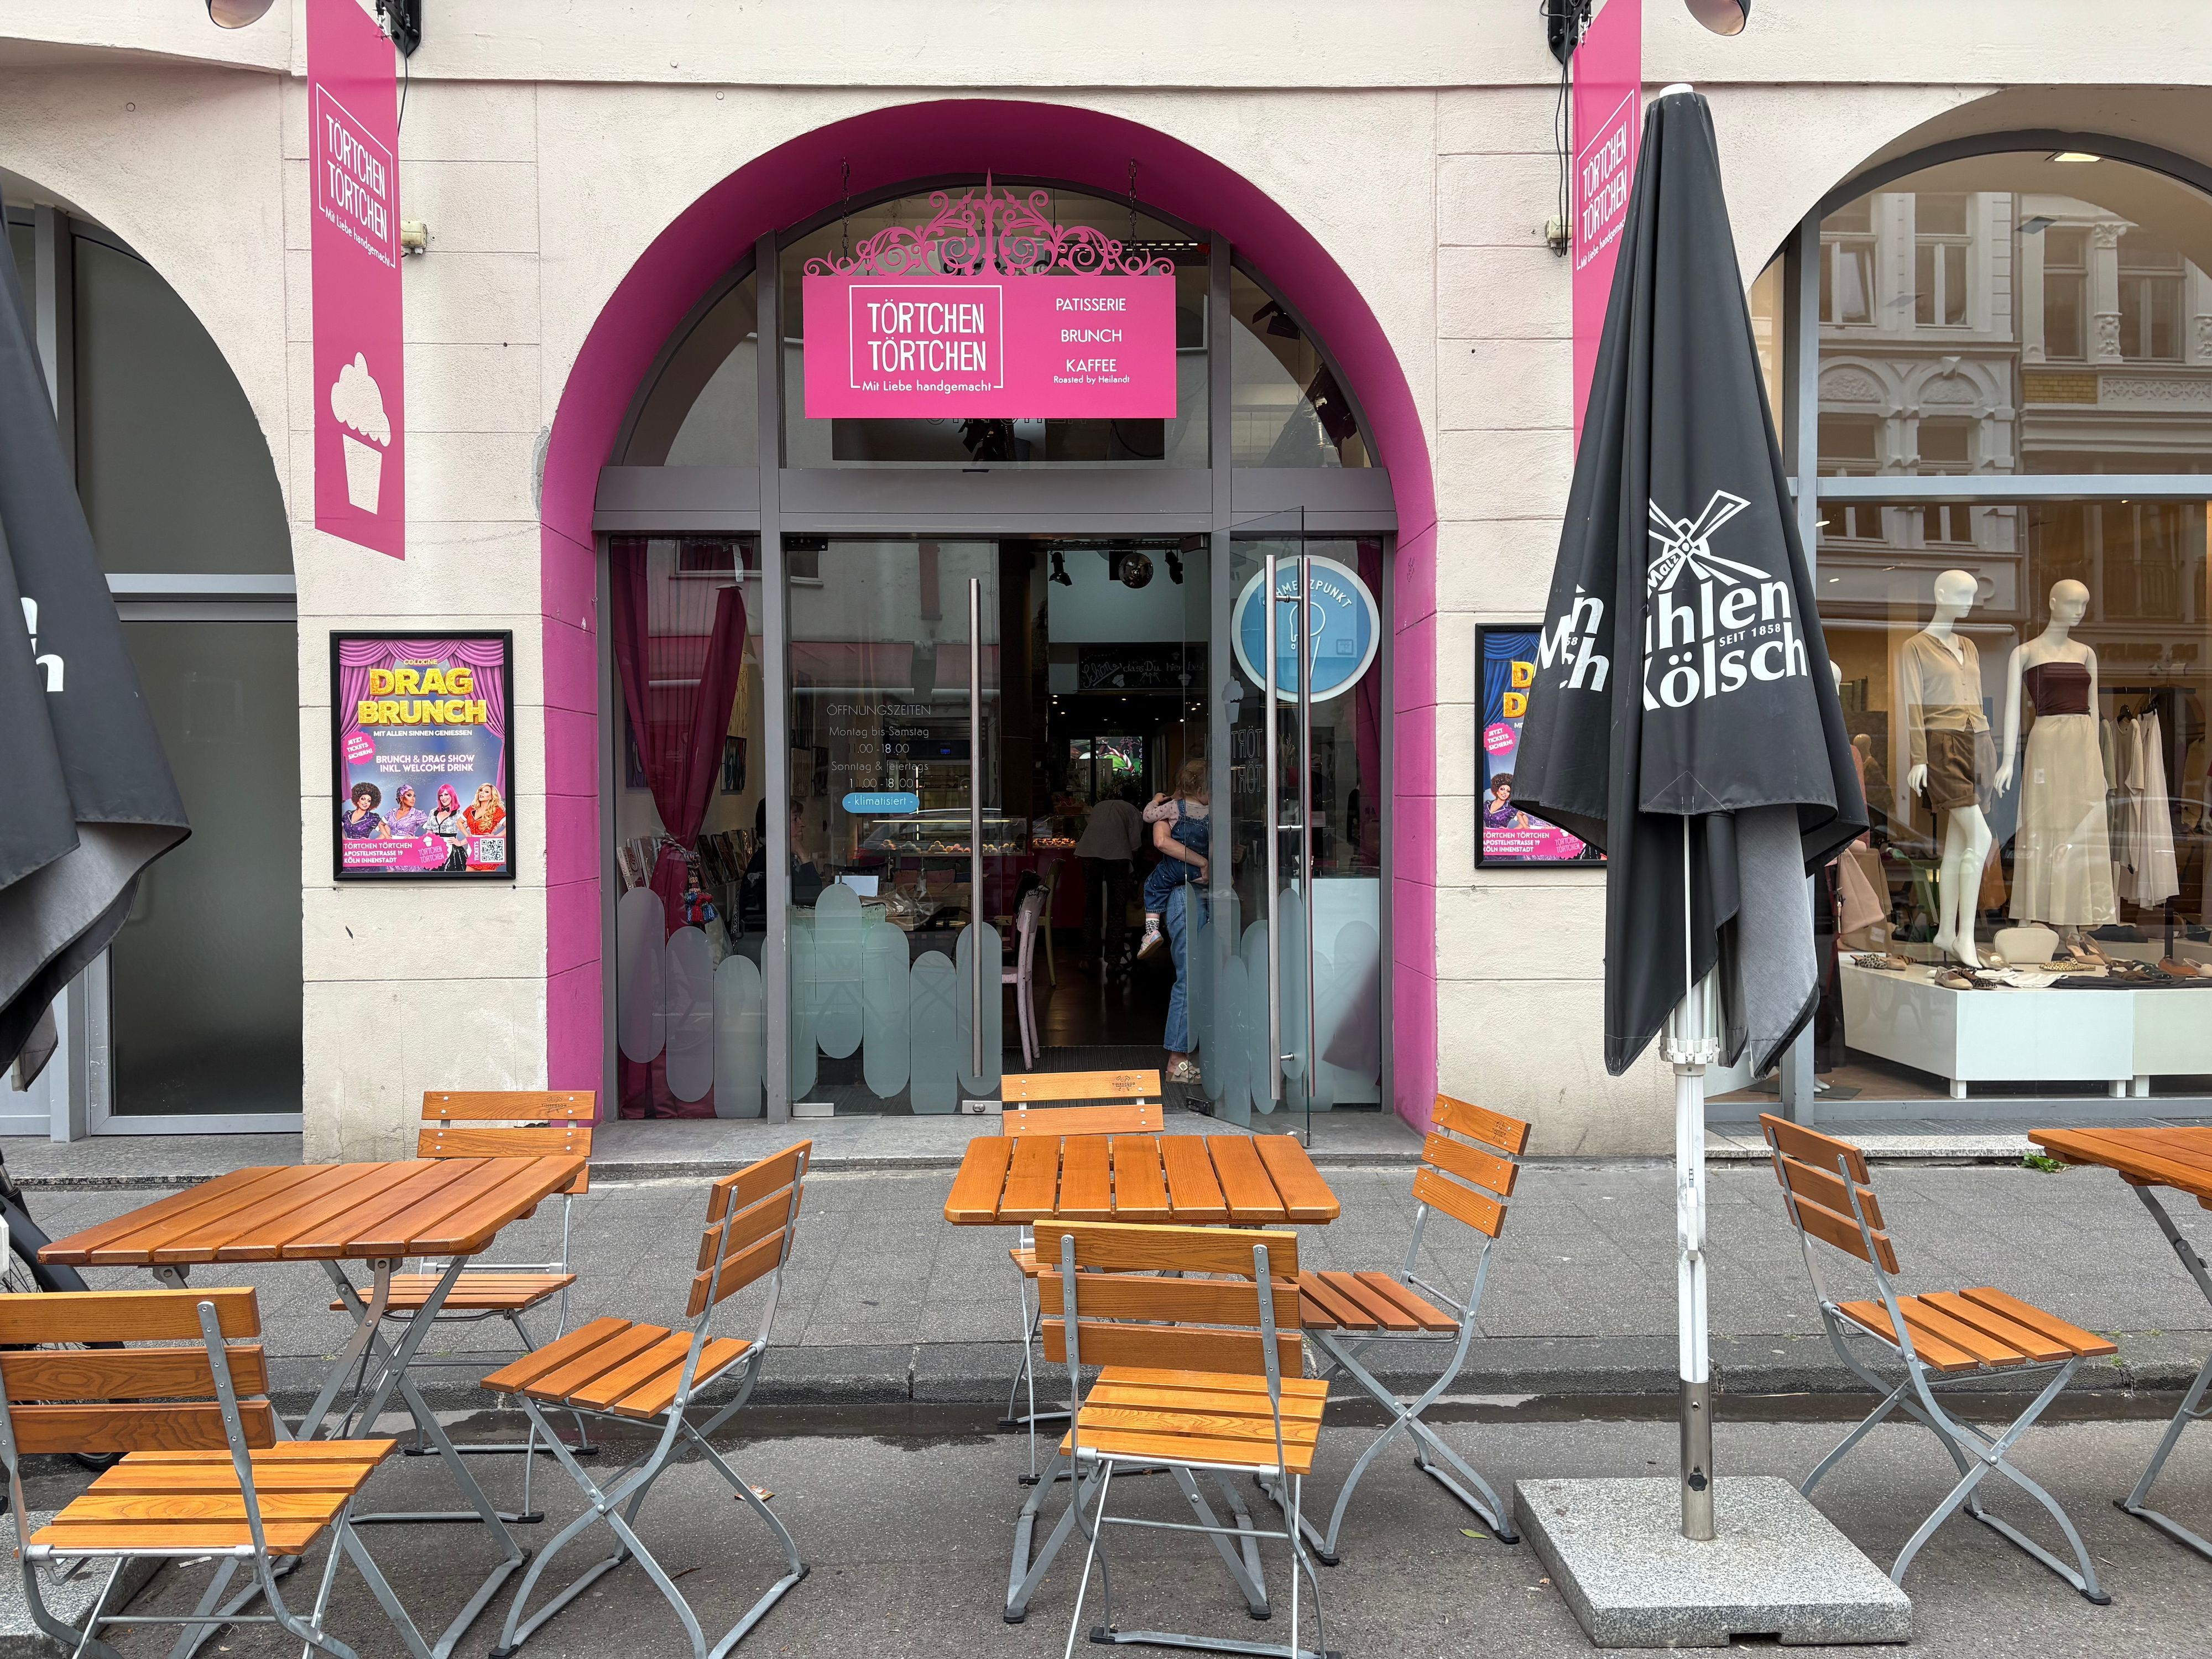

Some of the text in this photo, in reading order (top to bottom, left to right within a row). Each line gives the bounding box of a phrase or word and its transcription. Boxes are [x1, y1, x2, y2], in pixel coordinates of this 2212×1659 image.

[325, 113, 386, 201] TÖRTCHEN
[1582, 121, 1627, 202] TÖRTCHEN
[326, 159, 388, 243] TÖRTCHEN
[1582, 164, 1627, 244] TÖRTCHEN
[325, 206, 390, 267] Mit Liebe handgemacht
[1588, 244, 1599, 263] Liebe
[1056, 298, 1126, 311] PATISSERIE
[867, 298, 984, 335] TÖRTCHEN
[1061, 328, 1122, 342] BRUNCH
[867, 336, 987, 372] TÖRTCHEN
[1066, 358, 1117, 372] KAFFEE
[1053, 374, 1130, 385] Roasted by Heilandt
[862, 379, 992, 394] Mit Liebe handgemacht
[1647, 555, 1679, 588] Malz
[1262, 579, 1352, 608] HMEZPUNKT
[1646, 580, 1792, 656] hlen
[1719, 623, 1781, 647] SEIT 1858
[369, 667, 474, 696] DRAG
[358, 699, 487, 726] BRUNCH
[827, 703, 931, 716] ÖFFNUNGSZEITEN
[830, 726, 929, 739] Montag bis Samstag
[1487, 733, 1509, 744] TICKETS
[1488, 728, 1503, 737] JETZT
[347, 742, 369, 753] TICKETS
[348, 737, 362, 745] JETZT
[1488, 739, 1514, 750] SICHERN!
[348, 748, 373, 760] SICHERN!
[376, 755, 411, 764] BRUNCH
[422, 755, 446, 764] DRAG
[448, 754, 475, 763] SHOW
[380, 763, 473, 773] INKL. WELCOME DRINK
[831, 761, 872, 774] Sonntag
[875, 761, 883, 771] &
[854, 795, 906, 806] klimatisiert
[343, 841, 413, 849] TÖRTCHEN TÖRTCHEN
[418, 845, 442, 857] TÖRTCHEN
[419, 852, 445, 864] TÖRTCHEN
